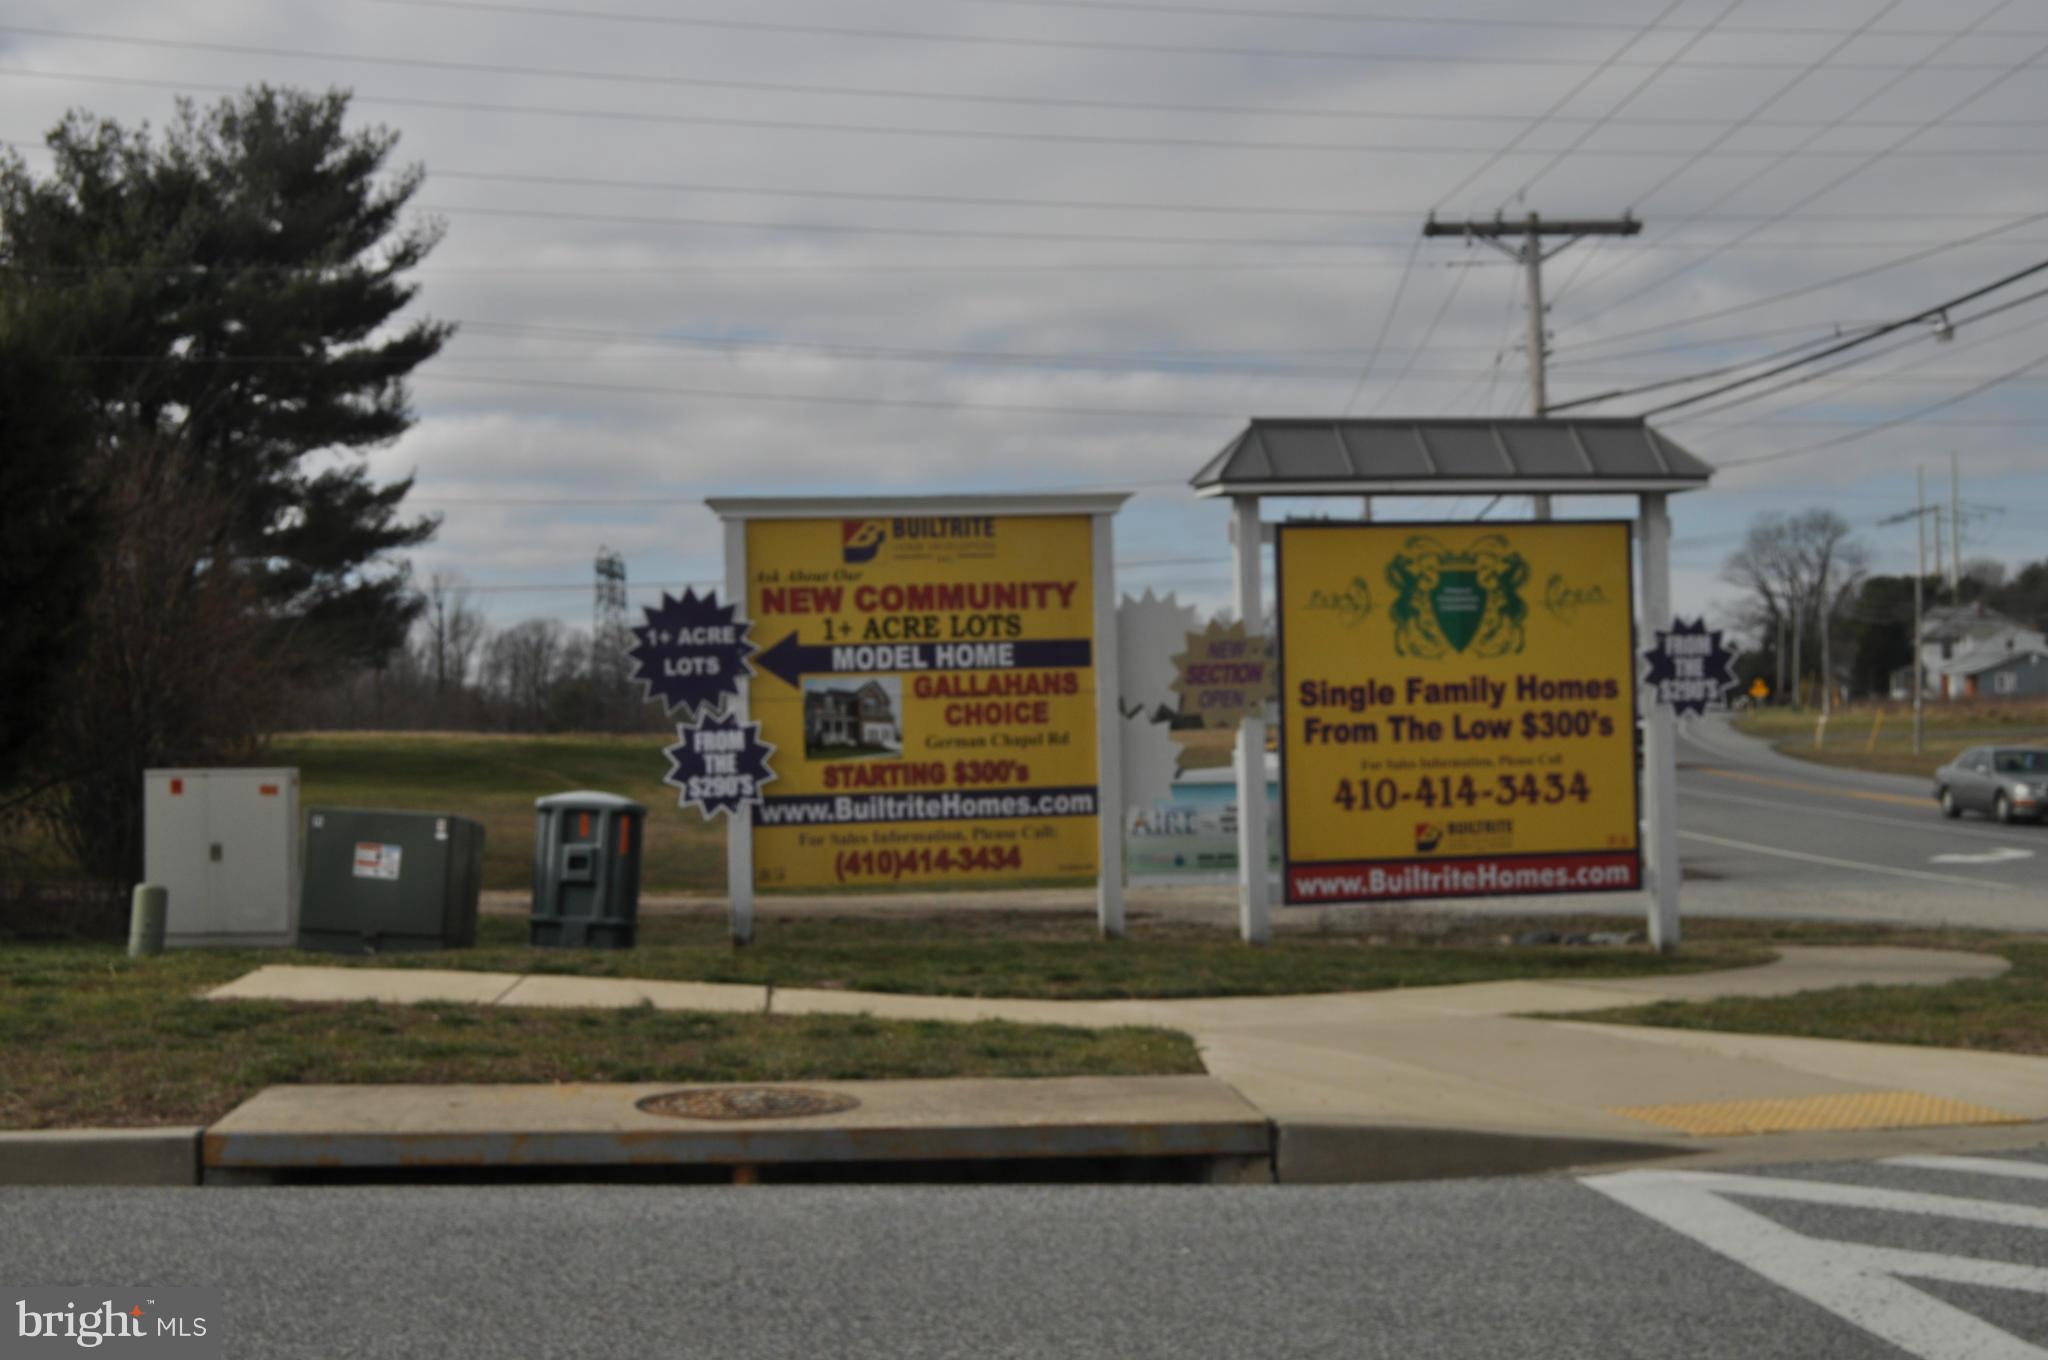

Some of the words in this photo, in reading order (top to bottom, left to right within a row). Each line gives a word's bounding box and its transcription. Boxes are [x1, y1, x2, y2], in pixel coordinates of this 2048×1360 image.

[892, 517, 997, 538] BUILTRITE
[761, 586, 842, 615] NEW
[855, 581, 1077, 613] COMMUNITY
[646, 628, 672, 648] 1+
[676, 625, 737, 646] ACRE
[823, 619, 853, 641] 1+
[863, 616, 941, 639] ACRE
[951, 614, 1022, 638] LOTS
[832, 646, 927, 672] MODEL
[935, 643, 1015, 668] HOME
[1208, 641, 1245, 657] NEW
[664, 655, 721, 677] LOTS
[1187, 664, 1262, 684] SECTION
[913, 671, 1079, 699] GALLAHANS
[1299, 679, 1395, 713] Single
[1405, 675, 1506, 709] Family
[1516, 674, 1619, 701] Homes
[1201, 690, 1243, 707] OPEN
[944, 702, 1049, 726] CHOICE
[1304, 718, 1379, 744] From
[1388, 715, 1442, 742] The
[1453, 713, 1512, 740] Low
[1521, 711, 1614, 739] $300's
[693, 730, 746, 752] FROM
[989, 732, 1042, 751] Chapel
[1047, 731, 1070, 746] Rd
[703, 753, 737, 774] THE
[823, 763, 945, 788] STARTING
[953, 759, 1029, 785] $300's
[1334, 771, 1590, 812] 410-414-3434
[759, 792, 1093, 825] www.BuiltriteHomes.com
[800, 833, 825, 847] For
[835, 845, 1022, 883] (410)414-3434
[1296, 863, 1629, 897] www.BuiltriteHomes.com
